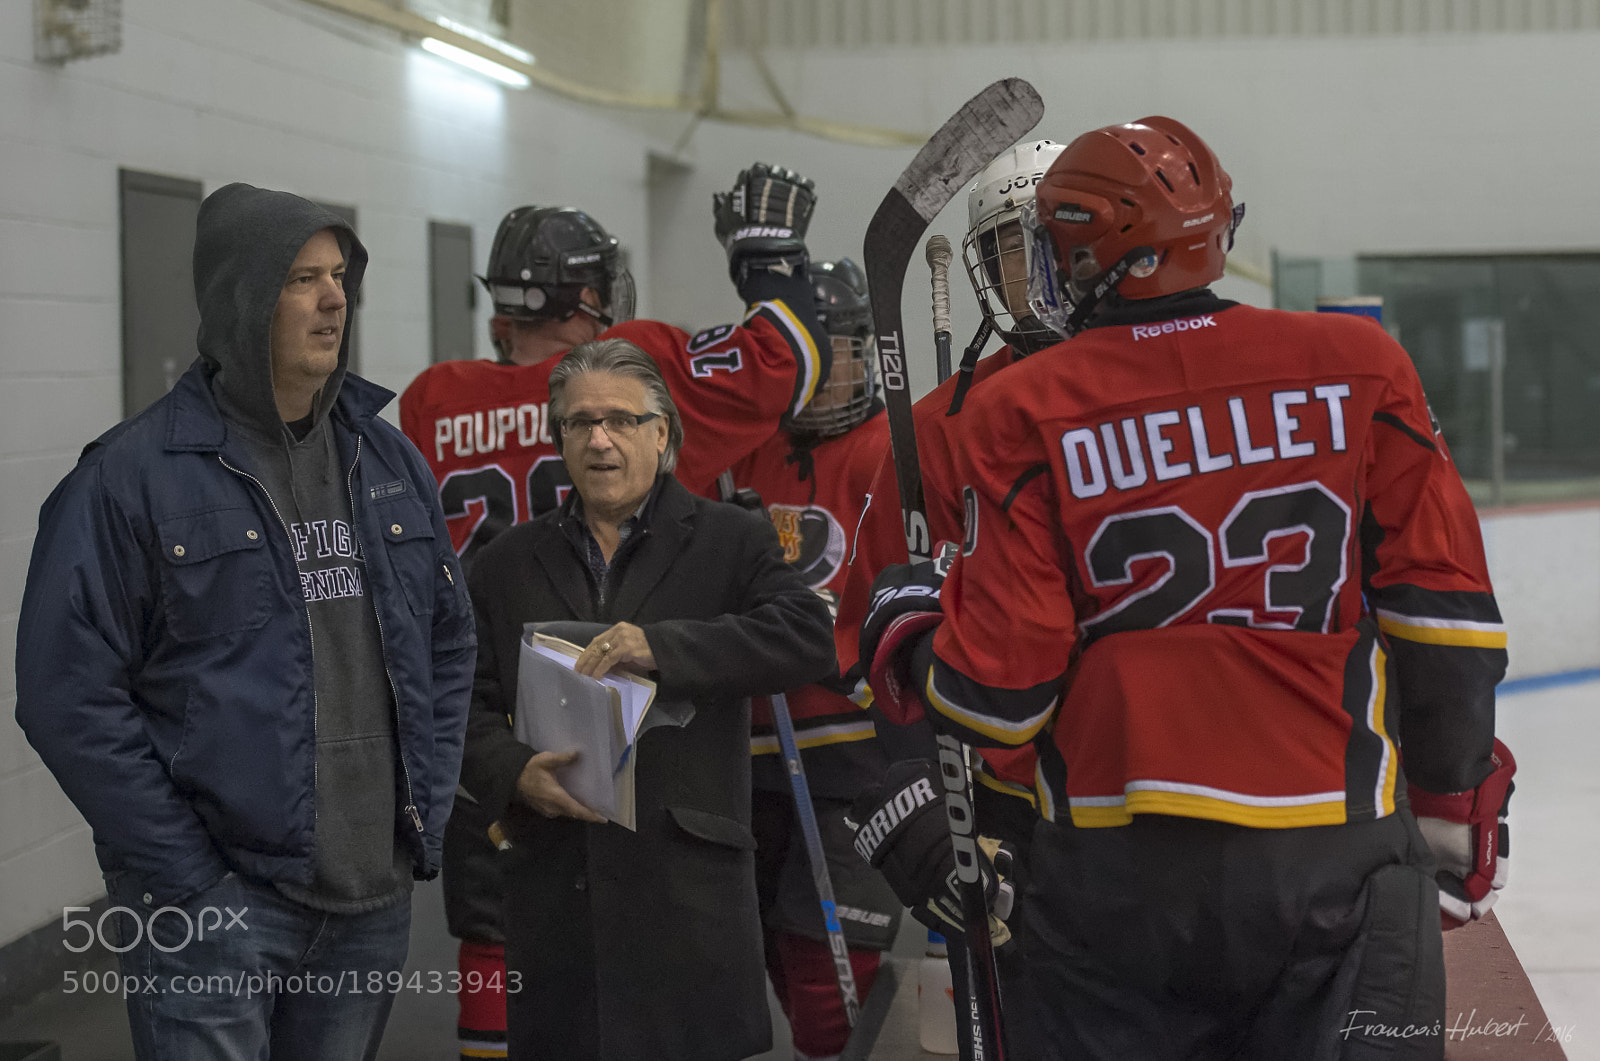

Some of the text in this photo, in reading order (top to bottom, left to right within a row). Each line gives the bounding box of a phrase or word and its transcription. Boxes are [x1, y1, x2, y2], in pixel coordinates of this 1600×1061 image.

[880, 330, 905, 391] T120
[1132, 314, 1217, 342] Reebok
[1060, 382, 1352, 500] OUELLET
[1078, 480, 1352, 638] 23
